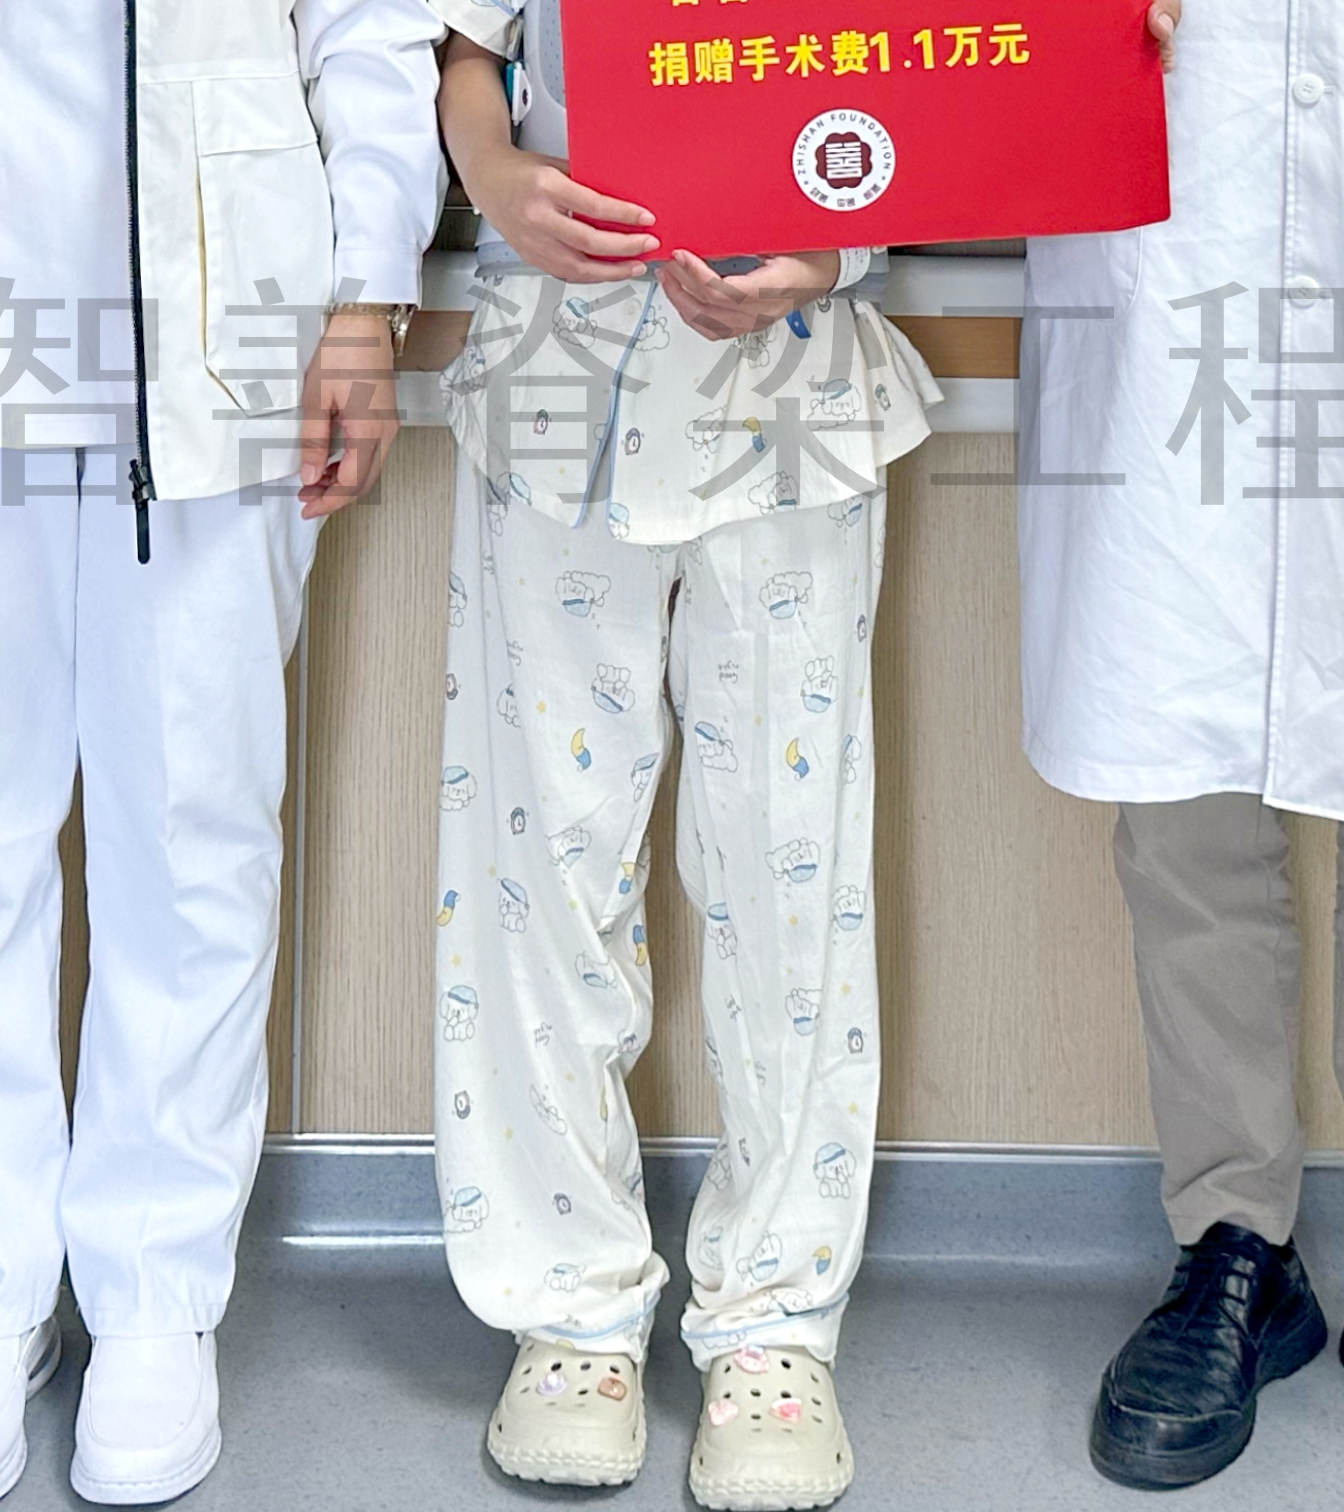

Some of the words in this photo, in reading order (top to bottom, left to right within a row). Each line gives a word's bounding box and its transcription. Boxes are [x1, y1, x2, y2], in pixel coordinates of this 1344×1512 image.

[648, 22, 1031, 88] 捐赠手术费1.1万元
[796, 119, 825, 176] ZHISHAN
[830, 112, 892, 170] FOUNDATION
